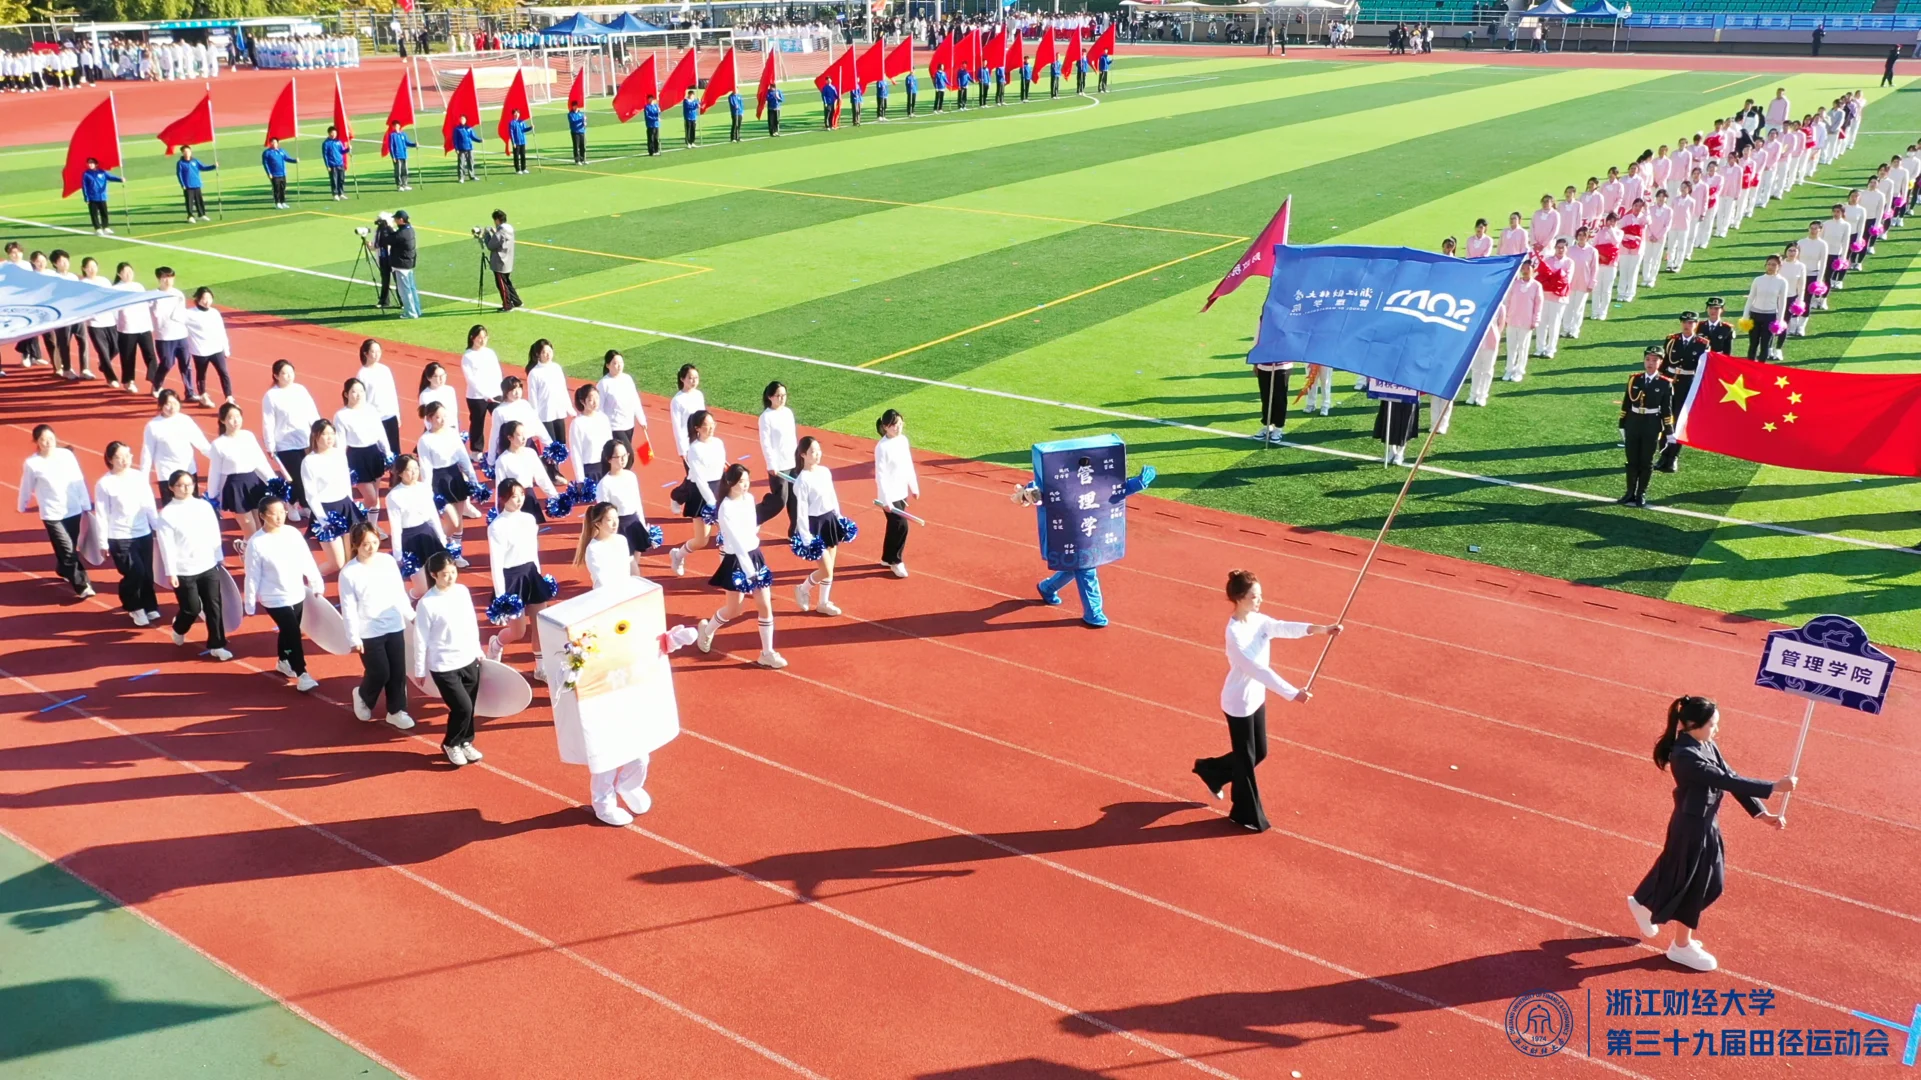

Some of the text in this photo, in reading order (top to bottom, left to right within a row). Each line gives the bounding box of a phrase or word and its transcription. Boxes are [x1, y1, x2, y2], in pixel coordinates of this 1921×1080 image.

[1077, 464, 1100, 538] 管理学
[1781, 648, 1874, 685] 管理学院
